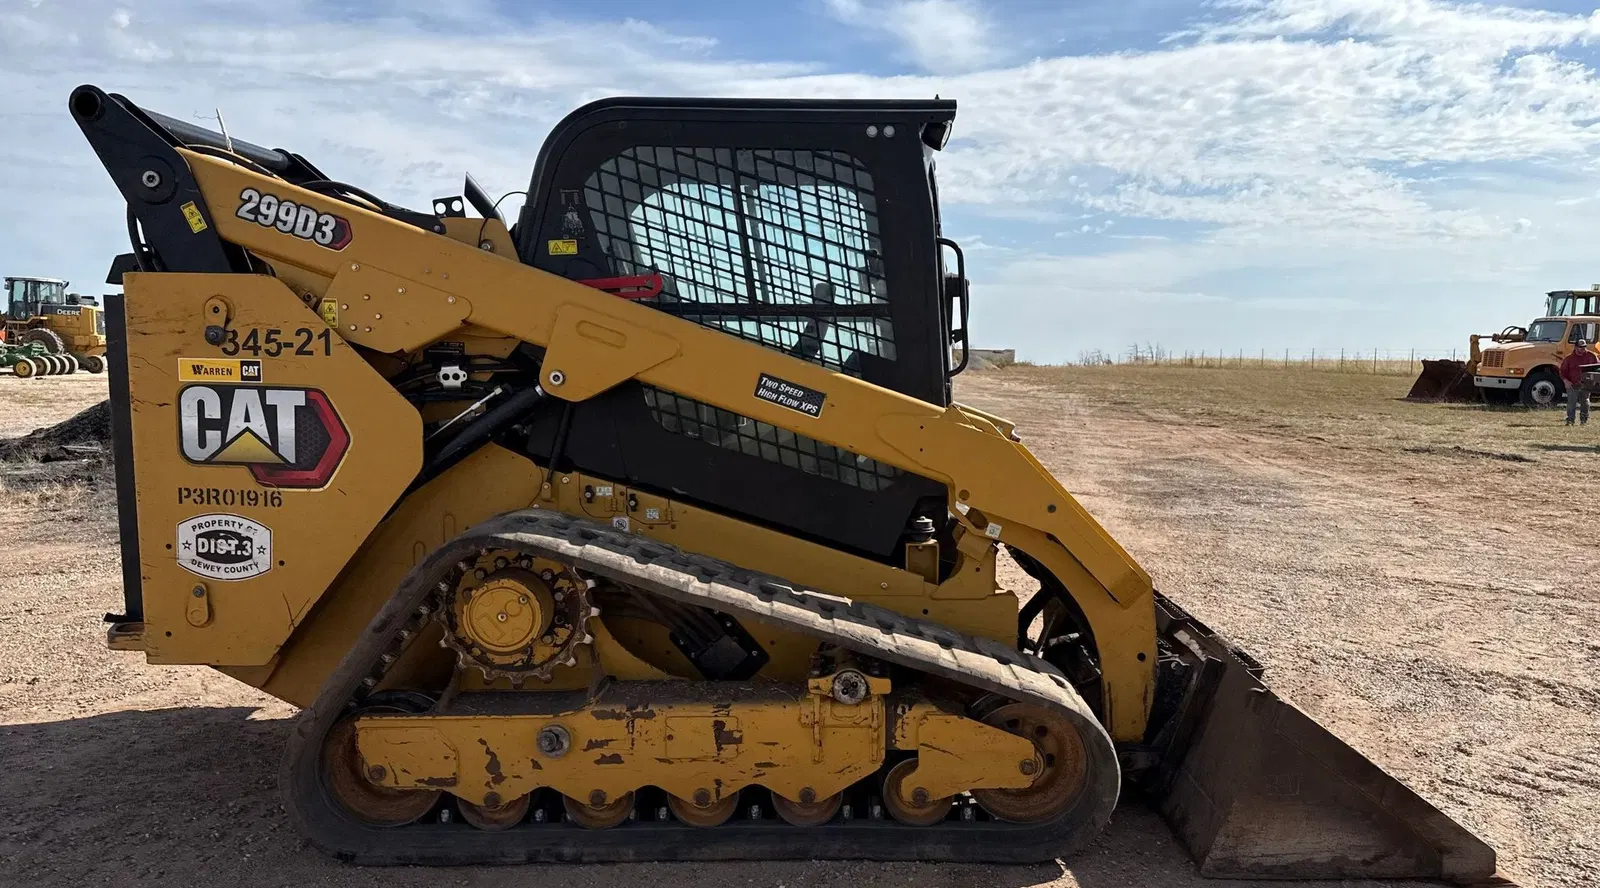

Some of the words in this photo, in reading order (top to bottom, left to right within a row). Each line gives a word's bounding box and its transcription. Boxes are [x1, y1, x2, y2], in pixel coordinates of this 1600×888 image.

[236, 188, 336, 245] 299D3
[222, 328, 331, 357] 345-21
[192, 364, 232, 376] WARREN
[242, 365, 259, 377] CAT
[760, 377, 778, 389] TWO
[779, 383, 804, 398] SPEED
[757, 387, 778, 400] HIGH
[778, 394, 800, 408] FLOW
[800, 401, 818, 414] XPS
[181, 386, 306, 464] CAT
[178, 487, 282, 508] P3R01916
[191, 519, 243, 532] PROPERTY
[191, 558, 222, 572] DEWEY
[224, 562, 259, 574] COUNTY
